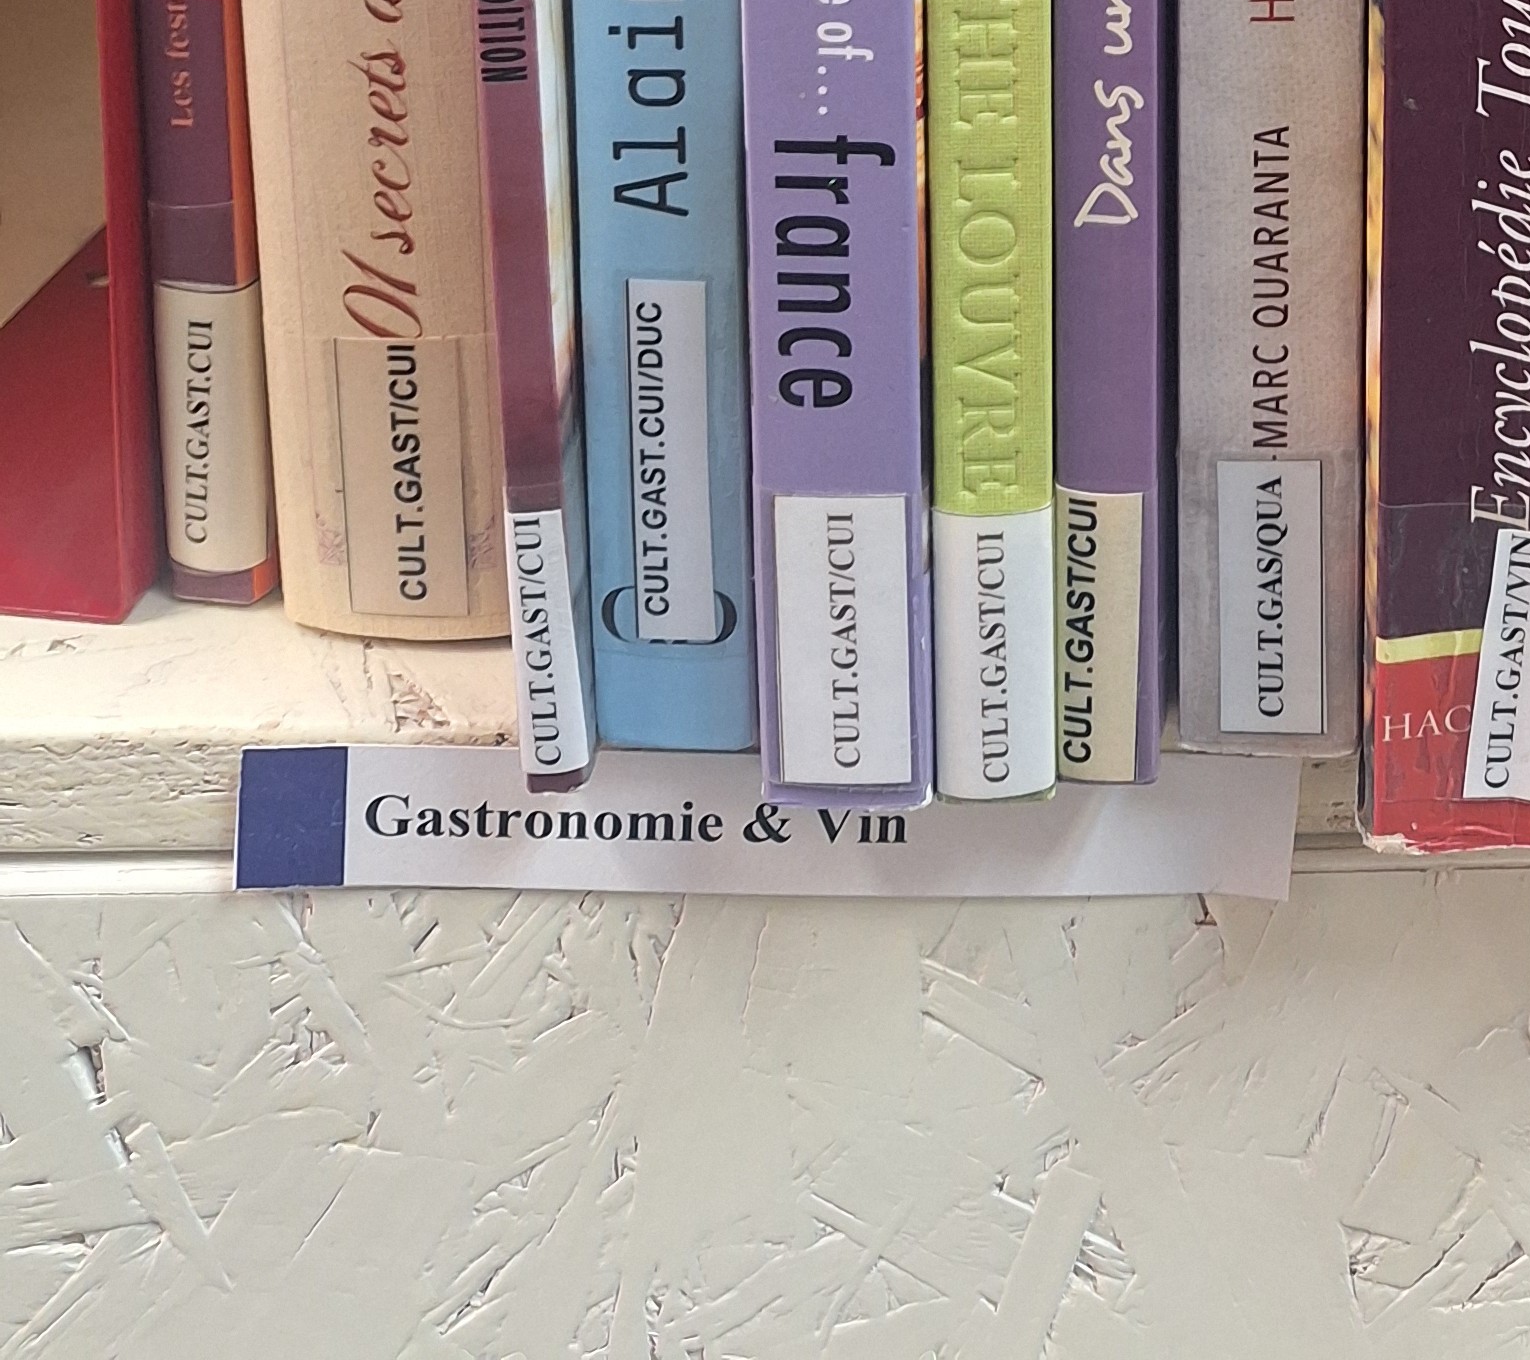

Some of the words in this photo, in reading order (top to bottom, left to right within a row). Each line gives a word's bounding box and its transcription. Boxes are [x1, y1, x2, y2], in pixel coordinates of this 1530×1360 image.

[170, 72, 194, 128] Les
[352, 44, 415, 255] secrets
[1075, 79, 1144, 231] Dans
[774, 133, 895, 411] france
[953, 144, 1023, 497] LOUVRE
[1253, 125, 1291, 327] QUARANTA
[183, 319, 214, 544] CULT.GAST.CUI
[387, 345, 427, 600] CULT.GAST/CUI
[635, 301, 670, 616] CULT.GAST.CUI/DUC
[1253, 345, 1289, 448] MARC
[513, 516, 561, 767] CULT.GAST/CUI
[827, 512, 861, 768] CULT.GAST/CUI
[976, 531, 1010, 783] CULT.GAST/CUI
[1063, 498, 1098, 764] CULT.GAST/CUI
[1256, 476, 1286, 717] CULT.GAS/QUA
[365, 793, 724, 843] Gastronomie
[744, 802, 791, 843] &
[816, 809, 908, 844] Vin
